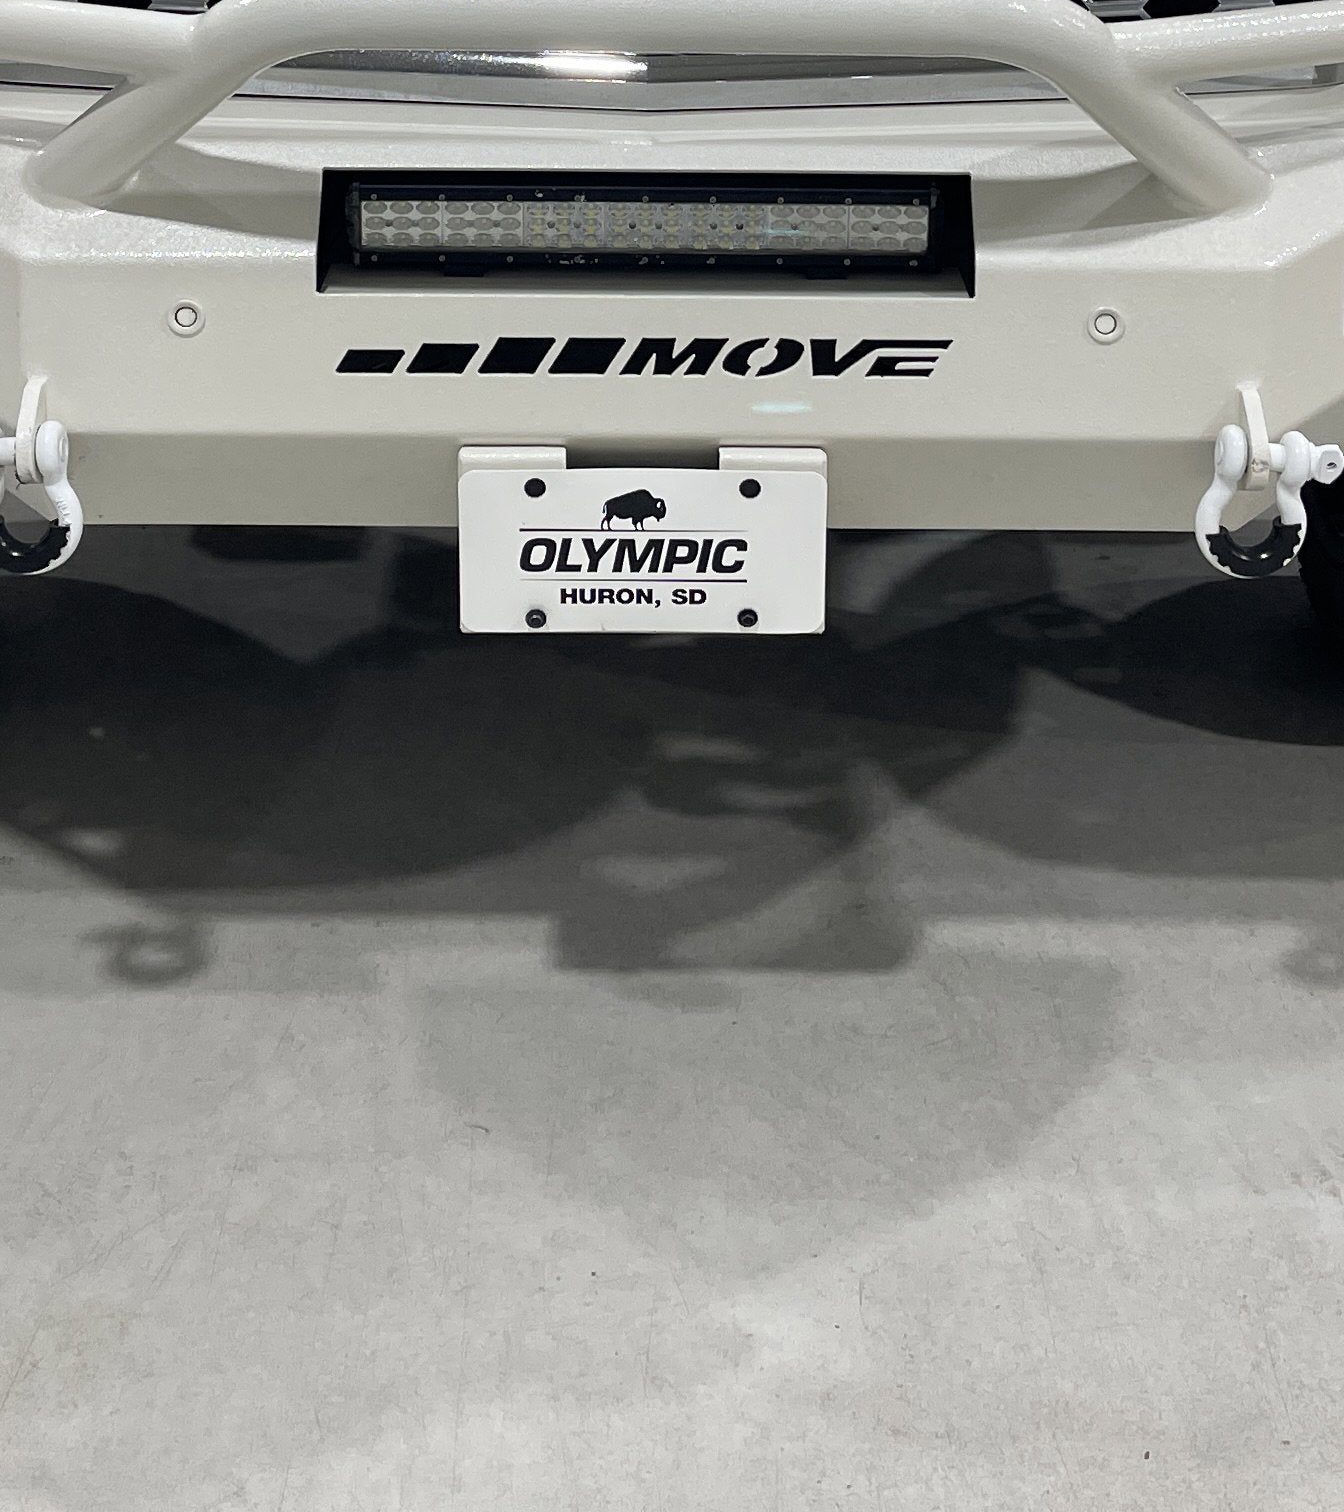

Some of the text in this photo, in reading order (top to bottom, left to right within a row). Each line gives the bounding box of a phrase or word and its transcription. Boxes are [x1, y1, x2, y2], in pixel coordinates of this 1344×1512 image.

[619, 337, 953, 378] MOVE
[519, 537, 749, 575] OLYMPIC
[560, 587, 708, 609] HURON, SD
